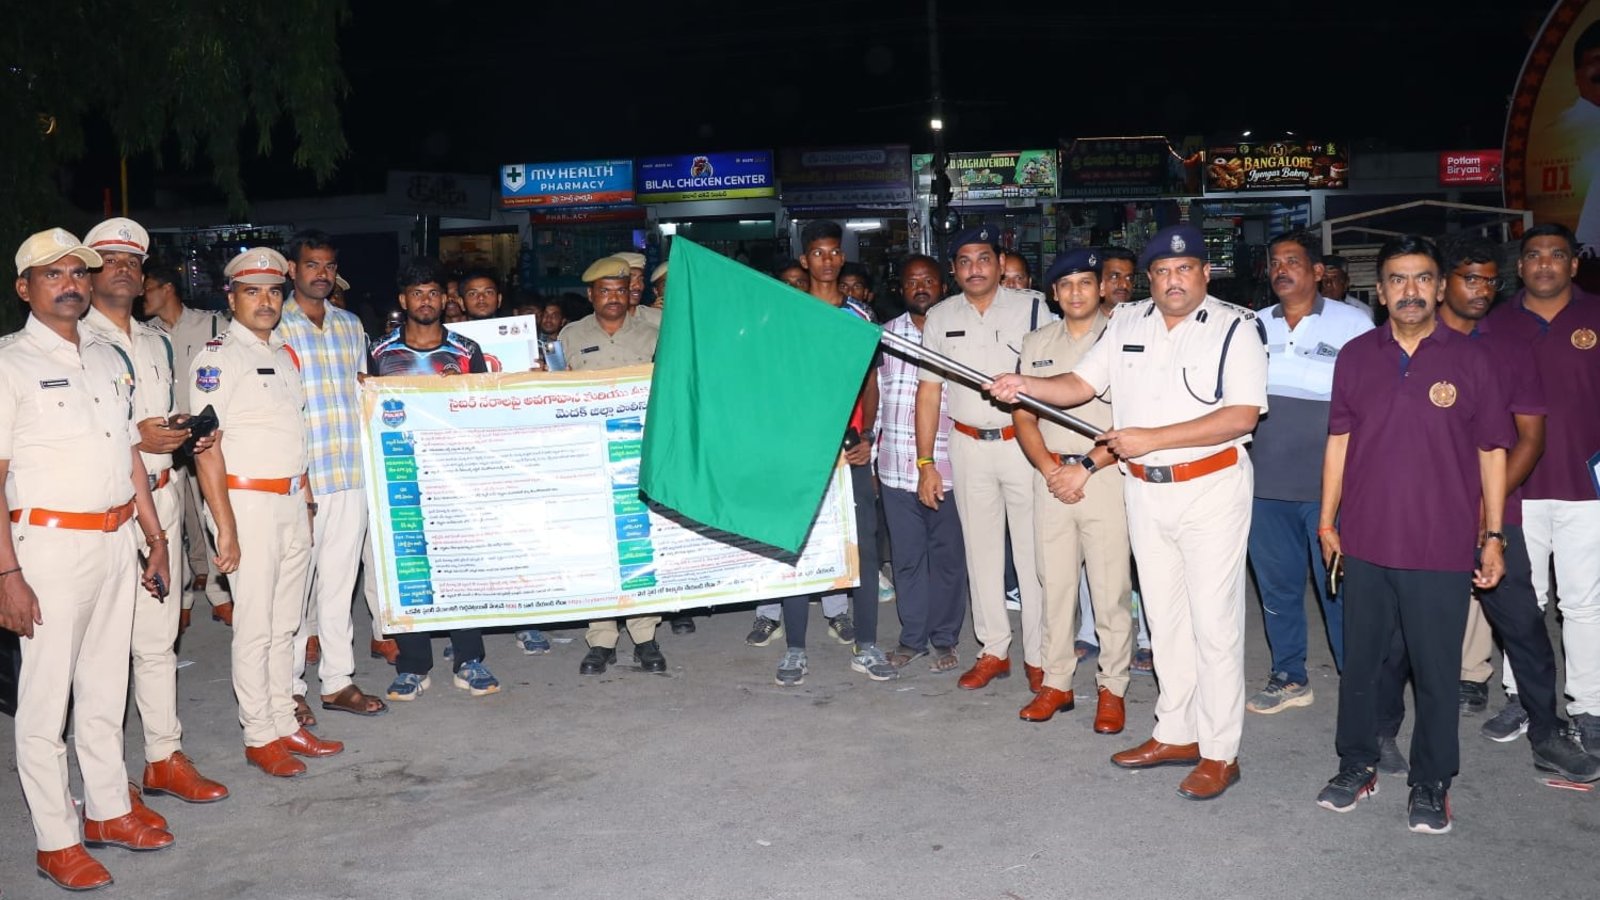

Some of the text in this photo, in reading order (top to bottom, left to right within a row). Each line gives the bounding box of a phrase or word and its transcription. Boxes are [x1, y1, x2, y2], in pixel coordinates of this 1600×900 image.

[957, 157, 1015, 169] RAGHAVENDRA
[1243, 156, 1313, 172] BANGALORE
[531, 165, 614, 181] MY HEALTH
[1281, 167, 1310, 180] Bakery
[1447, 165, 1481, 176] Biryani
[540, 180, 605, 192] PHARMACY
[645, 174, 766, 190] BILAL CHICKEN CENTER
